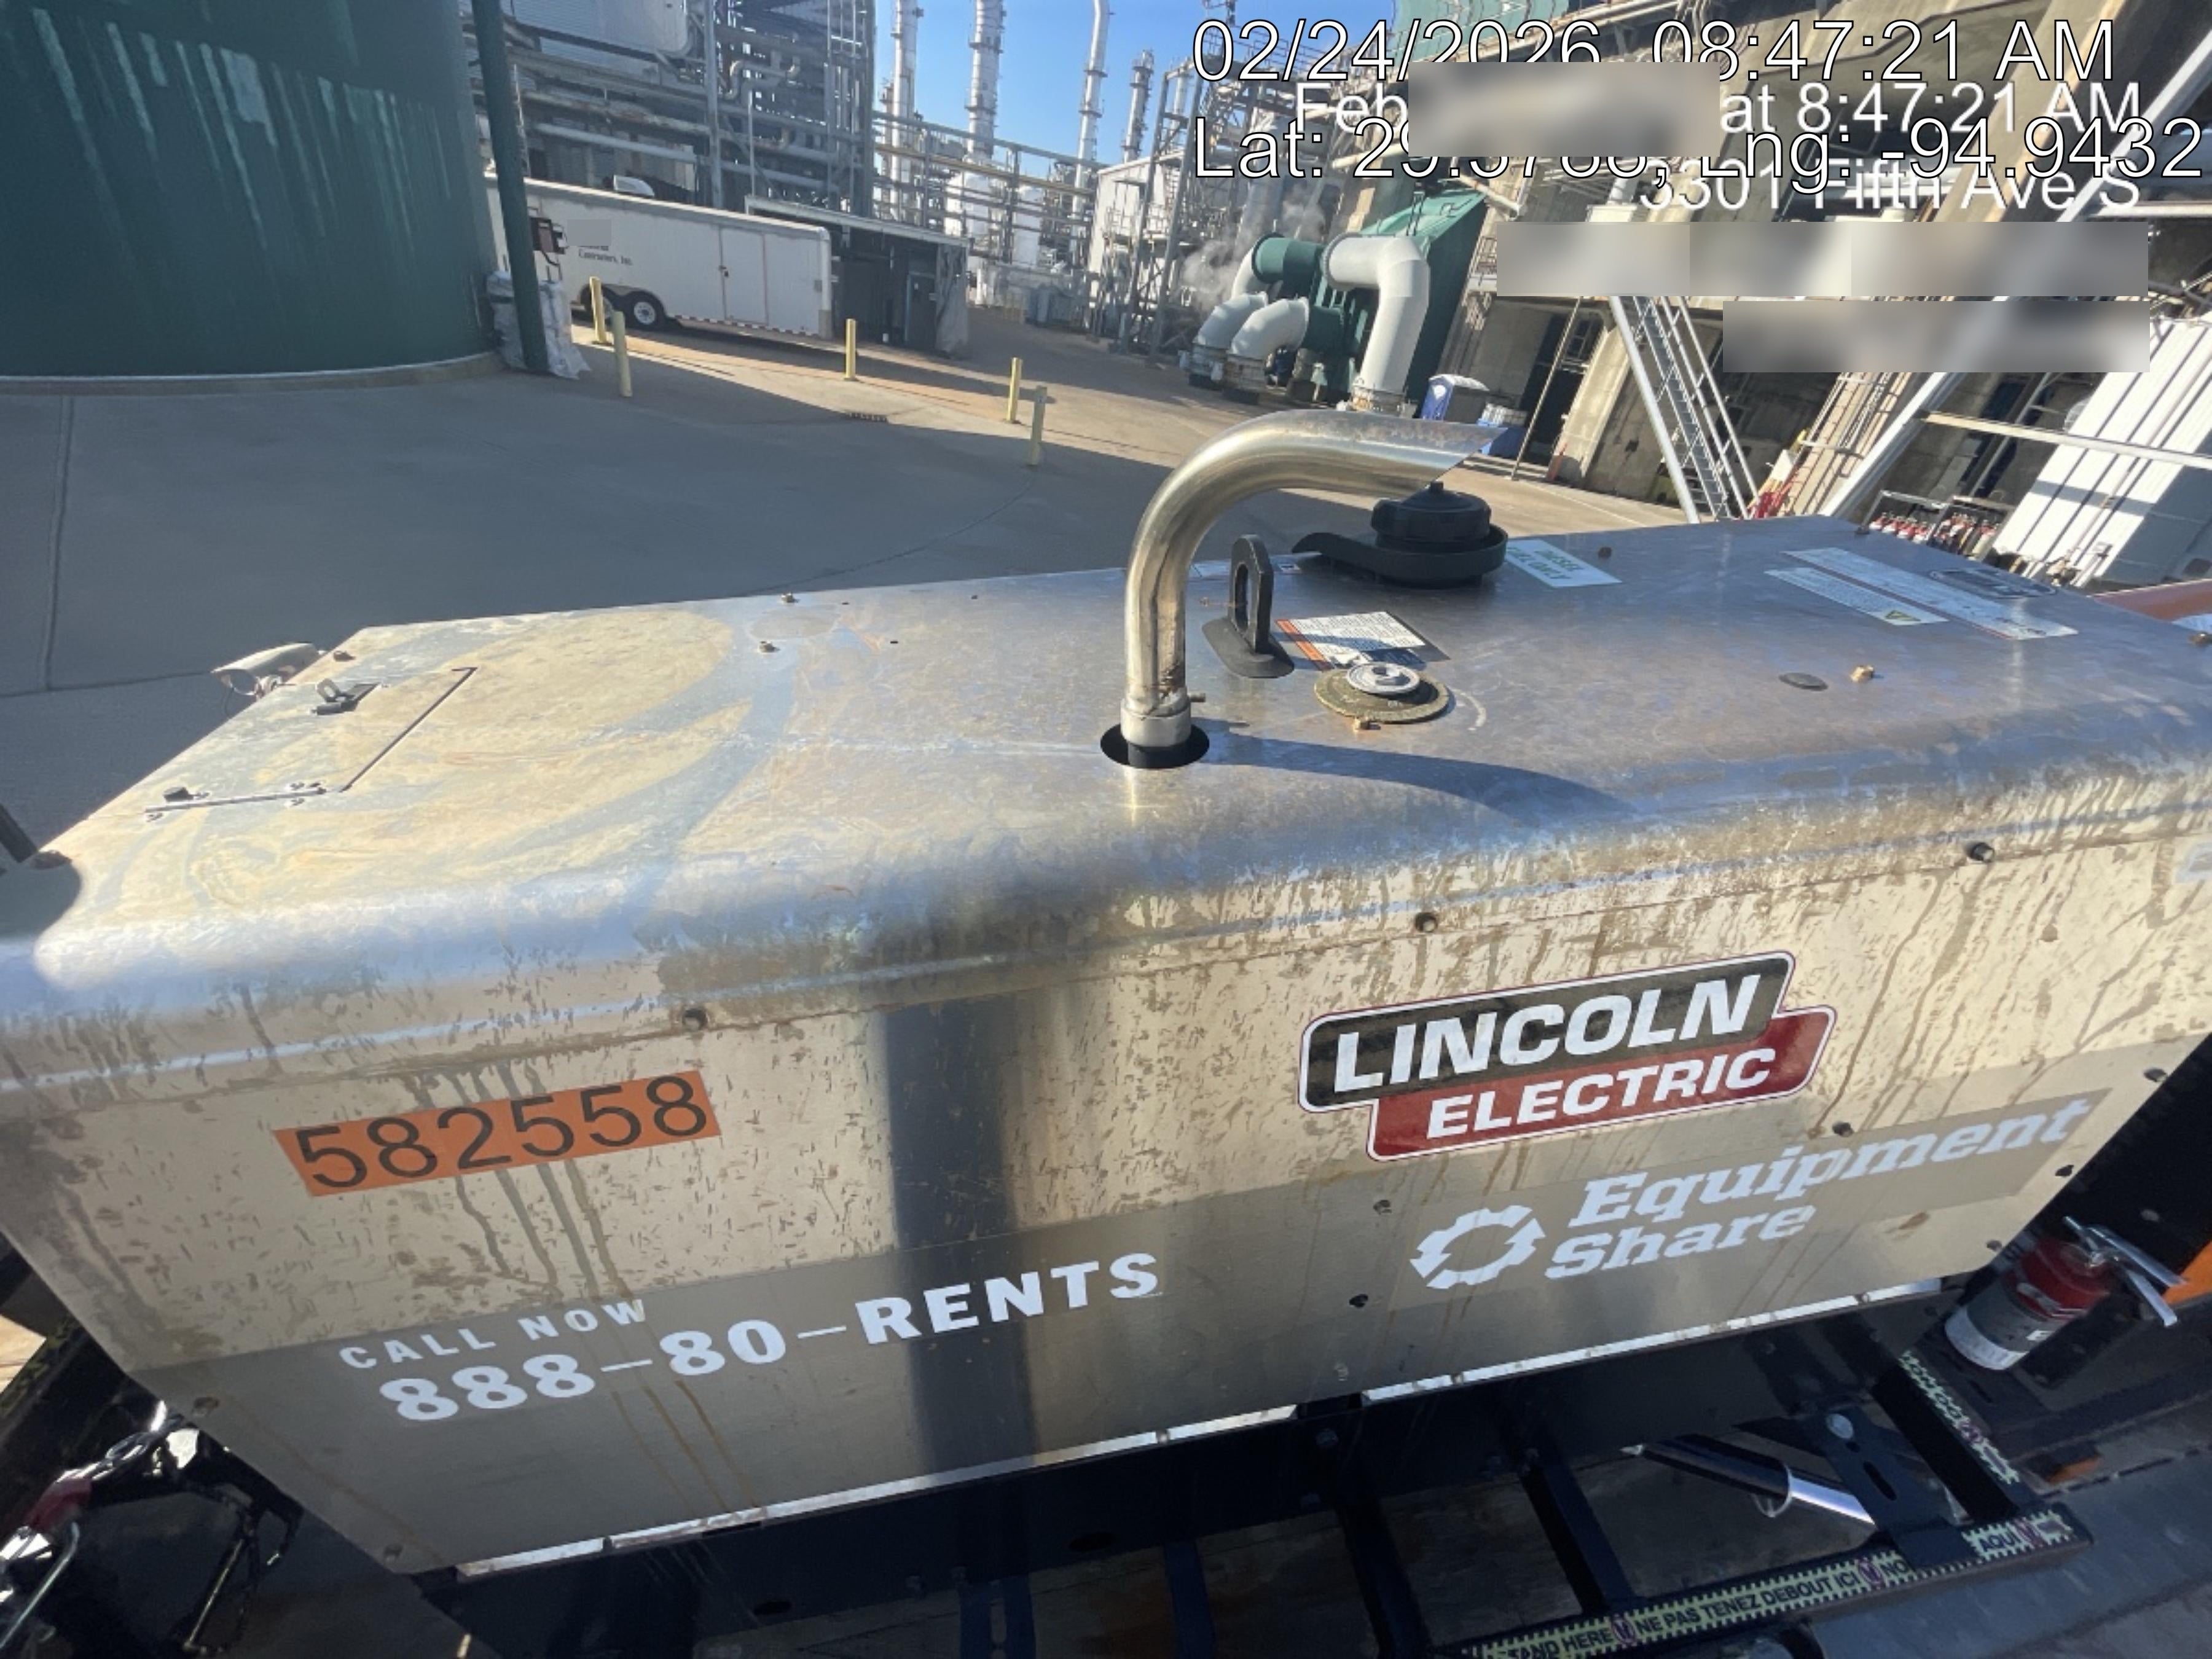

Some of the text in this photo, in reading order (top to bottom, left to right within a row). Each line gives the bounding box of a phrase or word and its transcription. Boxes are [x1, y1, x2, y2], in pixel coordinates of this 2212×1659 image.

[1334, 974, 1762, 1092] LINCOLN
[296, 1075, 707, 1188] 582558
[1426, 1048, 1776, 1139] ELECTRIC
[1568, 1097, 2089, 1229] Equipment
[1545, 1204, 1817, 1279] Share
[339, 1299, 646, 1368] CALL NOW
[379, 1252, 1159, 1421] 888-80-RENTS
[1561, 1628, 1614, 1652] HERE
[1634, 1615, 1660, 1636] NE
[1663, 1607, 1702, 1631] PAS
[1703, 1594, 1759, 1622] TENEZ
[1760, 1577, 1834, 1608] DEBOUT
[1836, 1571, 1861, 1589] ICI
[1881, 1558, 1907, 1580] NO
